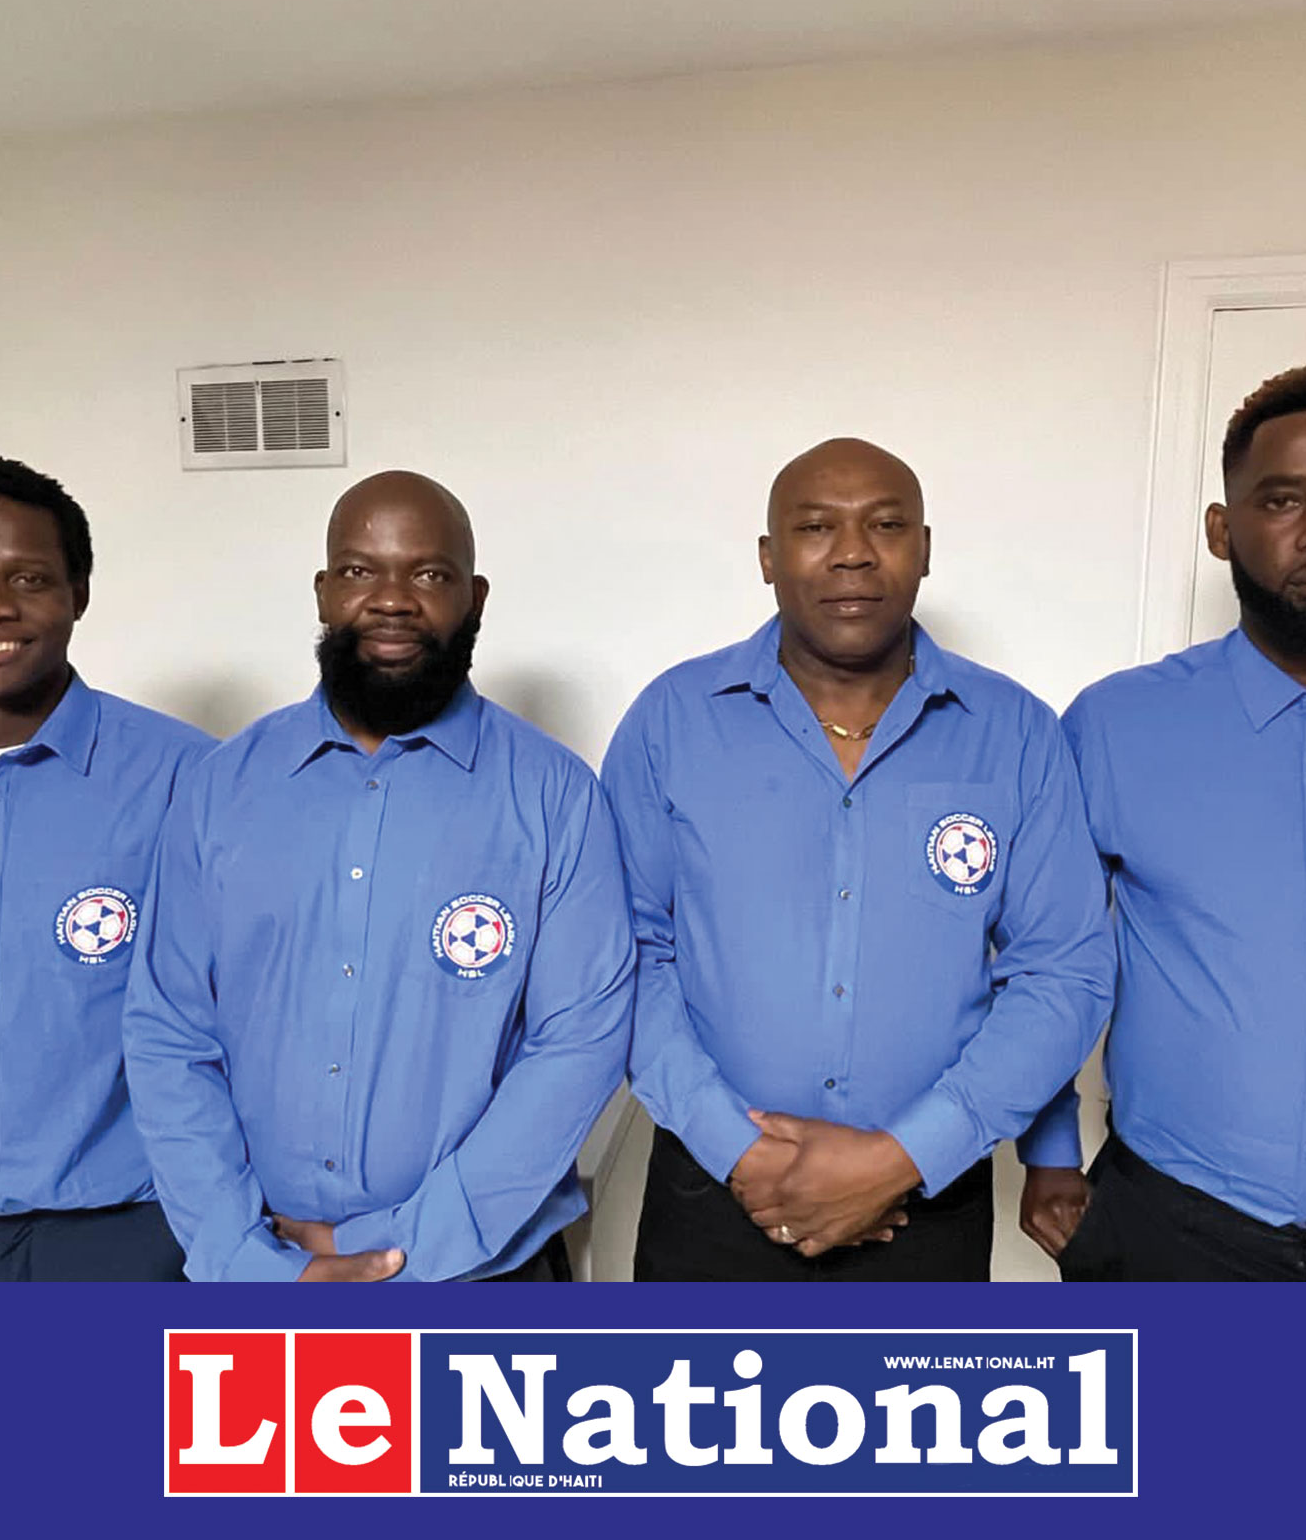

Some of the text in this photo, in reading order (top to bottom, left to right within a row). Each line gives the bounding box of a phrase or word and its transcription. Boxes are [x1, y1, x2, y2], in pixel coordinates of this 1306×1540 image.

[939, 814, 984, 827] SOCCER
[77, 887, 127, 901] SOCCER
[450, 894, 501, 909] SOCCER
